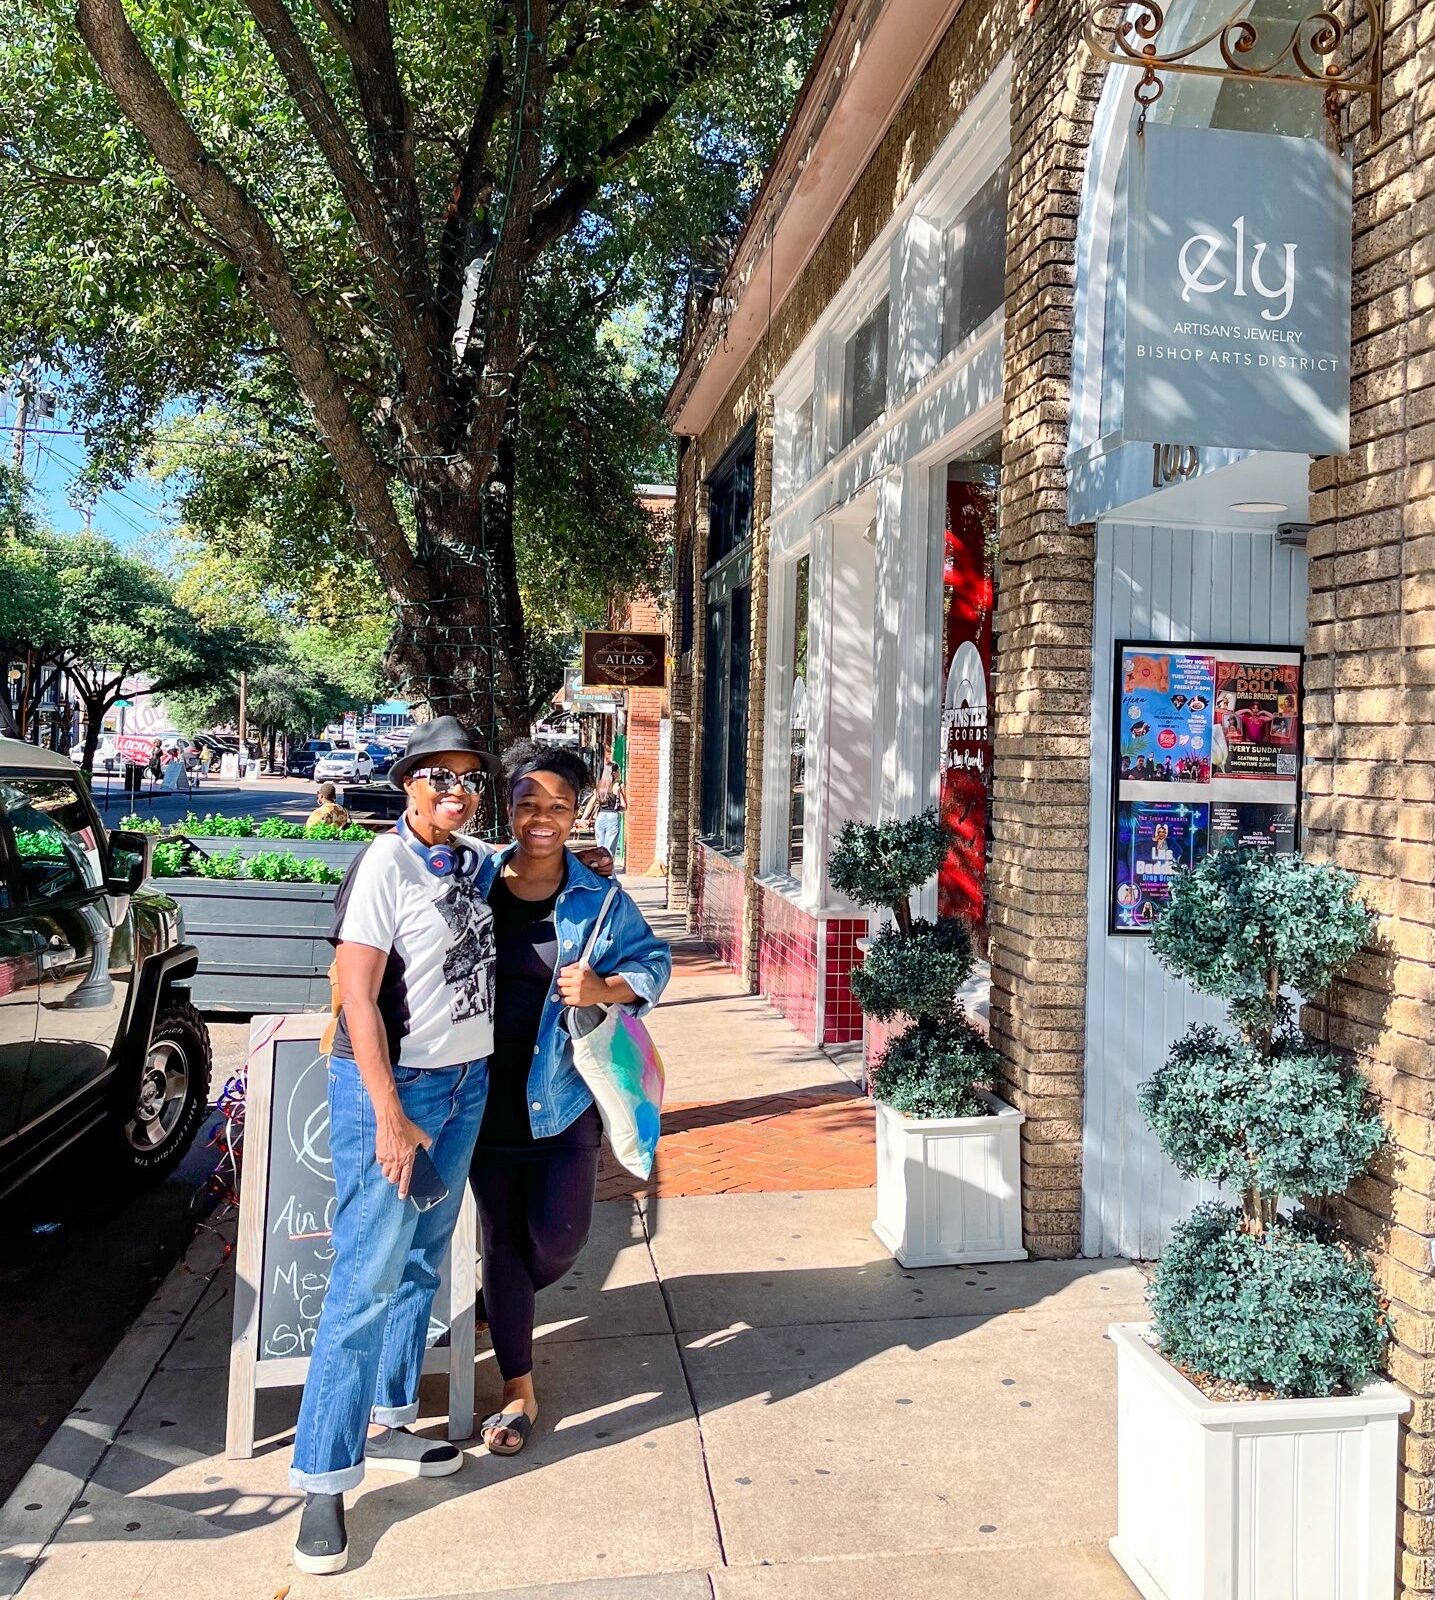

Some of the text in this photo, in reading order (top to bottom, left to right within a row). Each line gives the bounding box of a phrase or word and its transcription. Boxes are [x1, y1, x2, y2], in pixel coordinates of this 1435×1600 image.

[1178, 215, 1298, 321] ely
[1173, 322, 1304, 344] ARTISAN'S JEWELRY
[1137, 344, 1339, 372] BISHOP ARTS DISTRICT
[605, 654, 645, 665] ATLAS
[1218, 664, 1297, 683] DIAMOND
[1236, 680, 1279, 694] DOLL
[1236, 691, 1278, 701] DRAG BRUNCH
[943, 707, 988, 728] SPINSTER
[944, 727, 989, 741] ECORDS
[1228, 745, 1282, 754] EVERY SUNDAY
[1142, 874, 1158, 883] Drag
